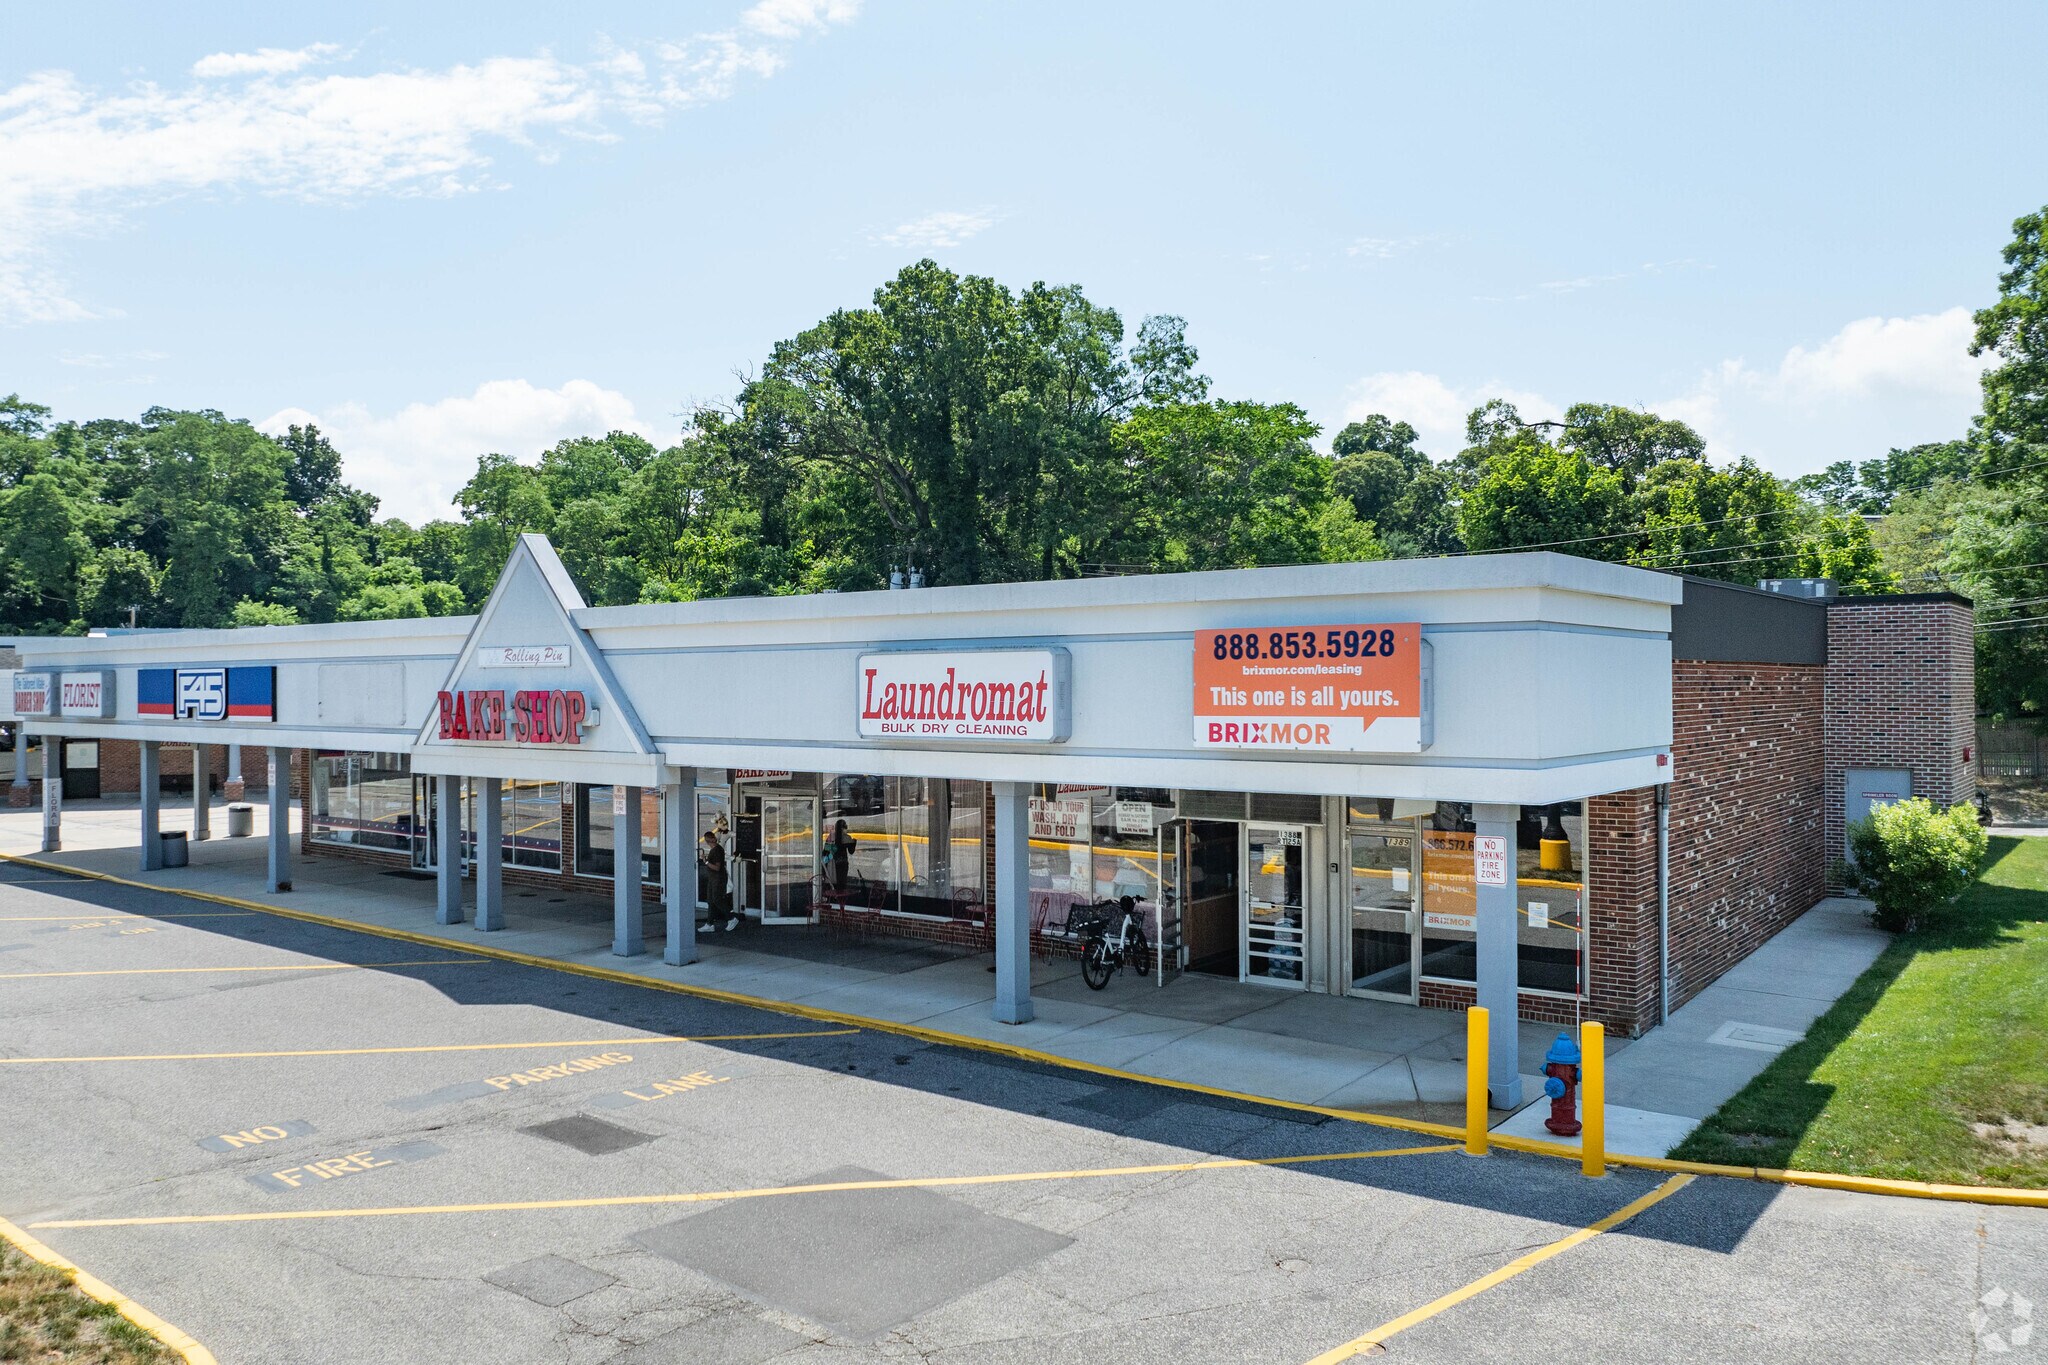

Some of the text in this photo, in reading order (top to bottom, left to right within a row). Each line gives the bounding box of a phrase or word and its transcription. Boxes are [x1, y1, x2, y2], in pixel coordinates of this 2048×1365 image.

[1213, 629, 1395, 660] 888.853.5928
[504, 647, 563, 666] Rolling Pin
[1242, 664, 1362, 676] brixmor.com/leasing
[63, 683, 101, 707] FLORIST
[177, 669, 225, 720] F45
[862, 667, 1048, 723] Laundromat
[1210, 686, 1248, 706] This
[1252, 690, 1285, 706] one
[1291, 686, 1307, 706] is
[1311, 686, 1334, 706] all
[1340, 689, 1400, 710] yours.
[437, 689, 586, 744] BAKE SHOP
[881, 723, 1028, 736] BULK DRY CLEANING
[1208, 723, 1331, 744] BRIXMOR
[1040, 800, 1049, 810] US
[1053, 801, 1063, 812] DO
[1066, 802, 1085, 813] YOUR
[1122, 803, 1146, 813] OPEN
[1032, 812, 1078, 825] WASH, DRY
[1035, 824, 1076, 837] AND FOLD
[1388, 839, 1409, 847] 1389
[1428, 838, 1474, 851] 866.572.6
[1484, 841, 1496, 850] NO
[1478, 851, 1504, 860] PARKING
[1482, 861, 1499, 870] FIRE
[1428, 871, 1447, 880] This
[1481, 870, 1501, 879] ZONE
[1428, 883, 1470, 893] all yours.
[1428, 916, 1471, 926] BRIXMOR
[219, 1051, 633, 1149] NO PARKING
[271, 1070, 732, 1187] FIRE LANE
